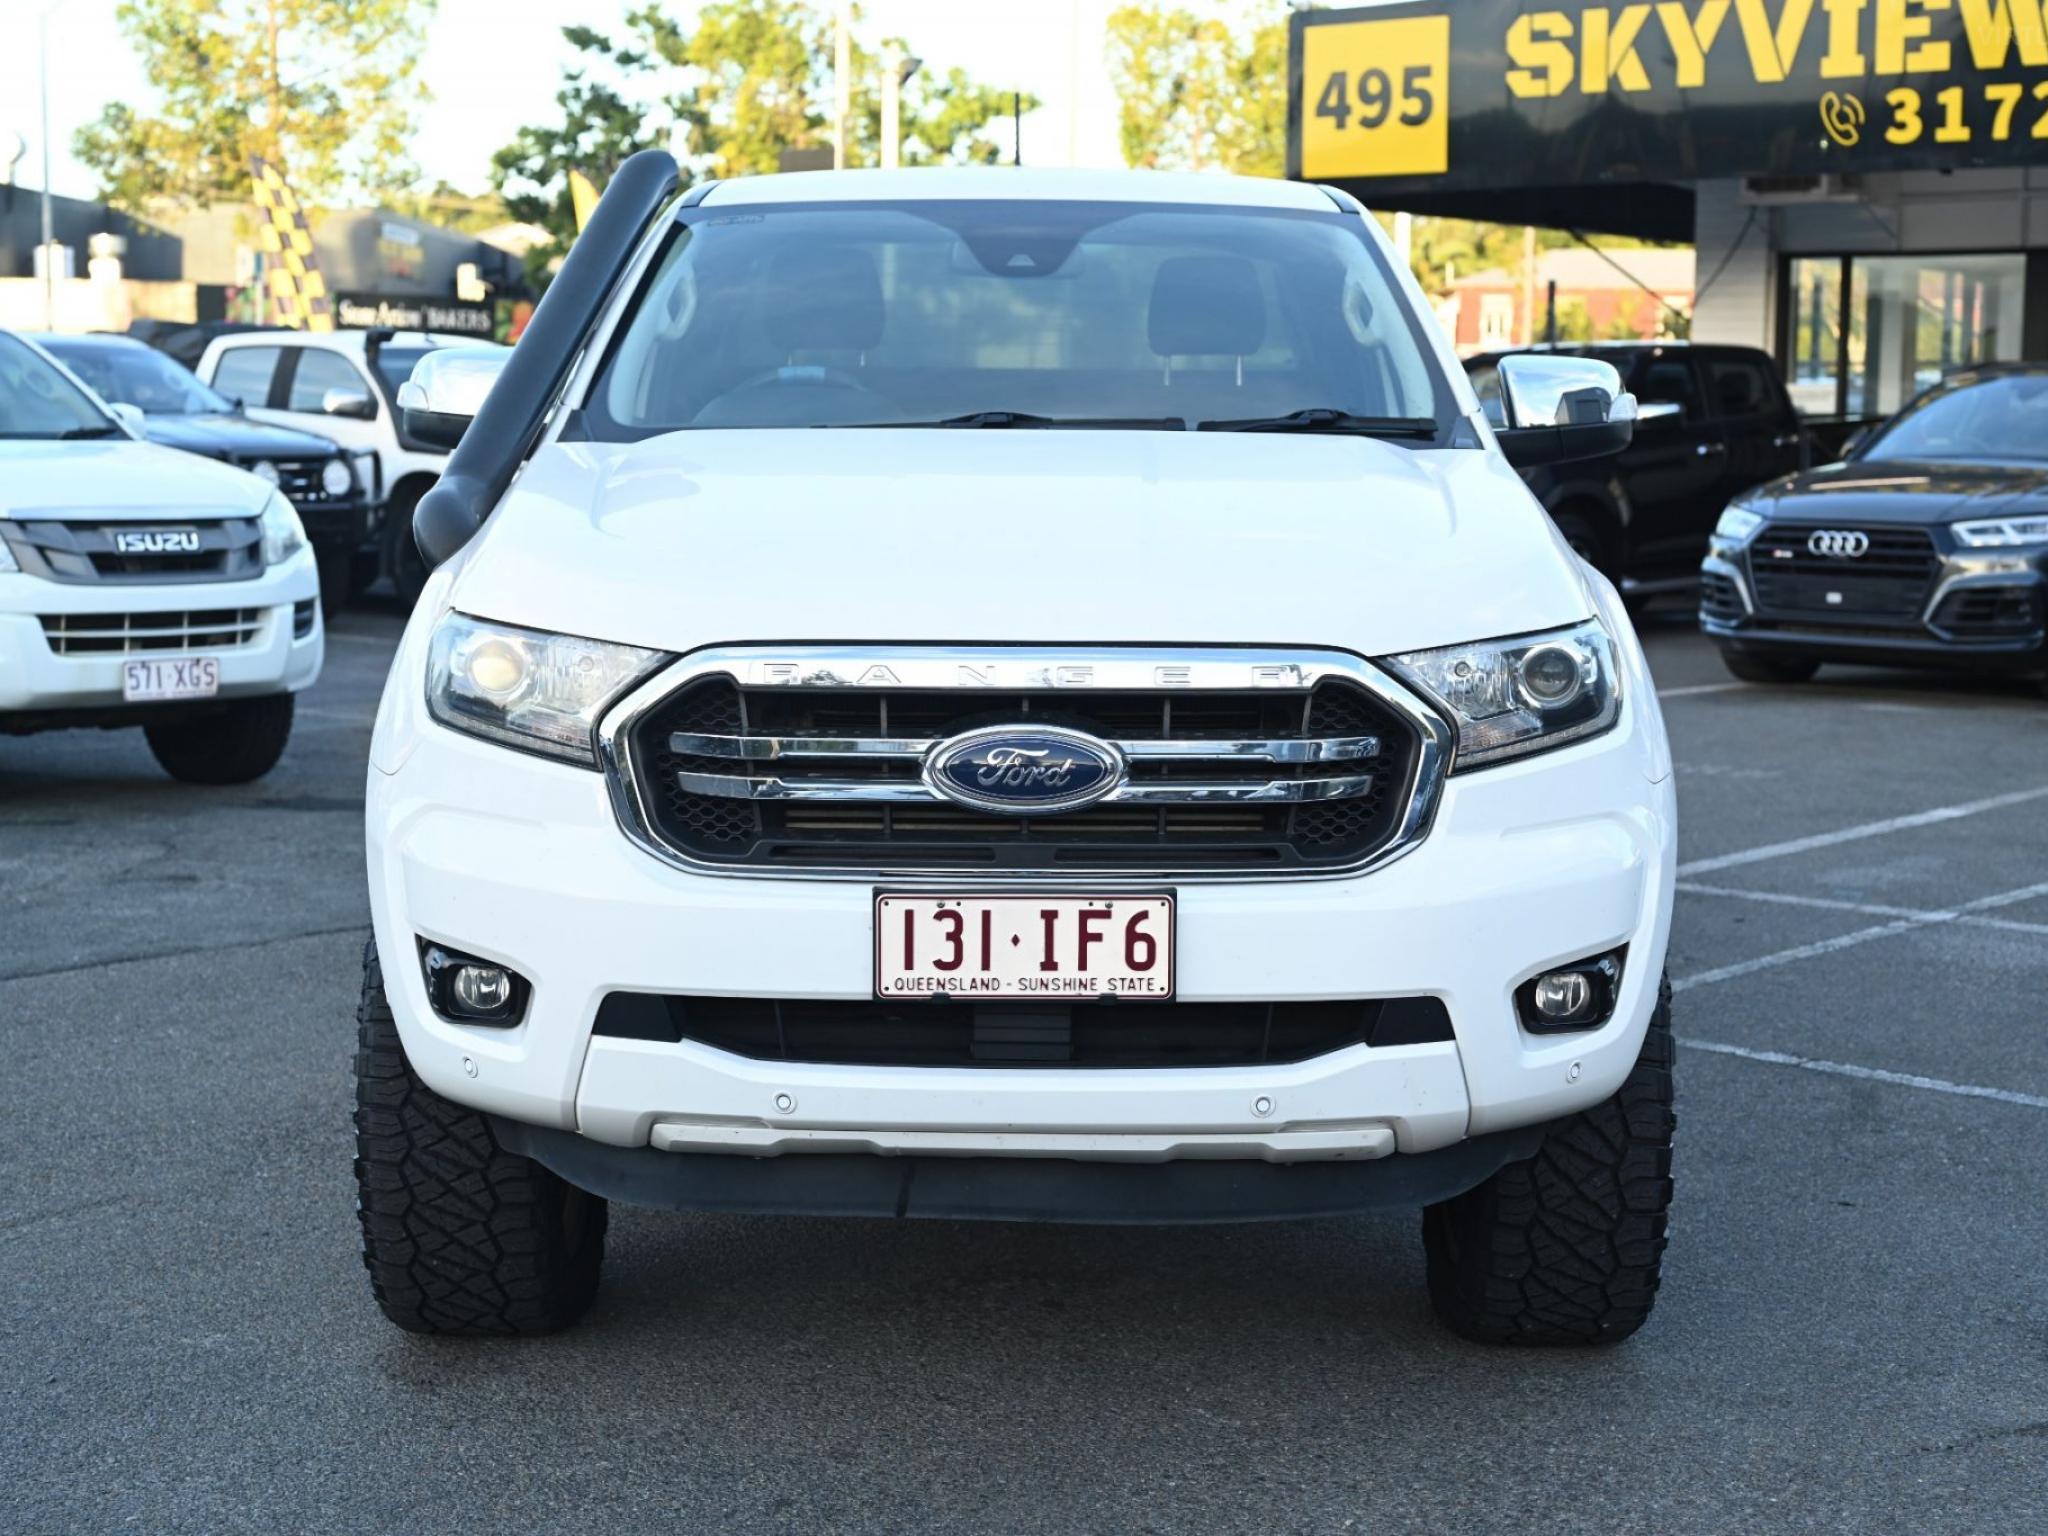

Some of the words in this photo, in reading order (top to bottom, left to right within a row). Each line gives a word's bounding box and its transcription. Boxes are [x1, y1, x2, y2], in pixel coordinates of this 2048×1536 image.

[1315, 65, 1434, 131] 495
[117, 532, 200, 552] ISUZU
[763, 662, 1291, 688] RANGER
[977, 747, 1077, 788] Ford
[894, 977, 1001, 991] QUEENSLAND
[1018, 977, 1098, 991] SUNSHINE
[1108, 977, 1155, 991] STATE
